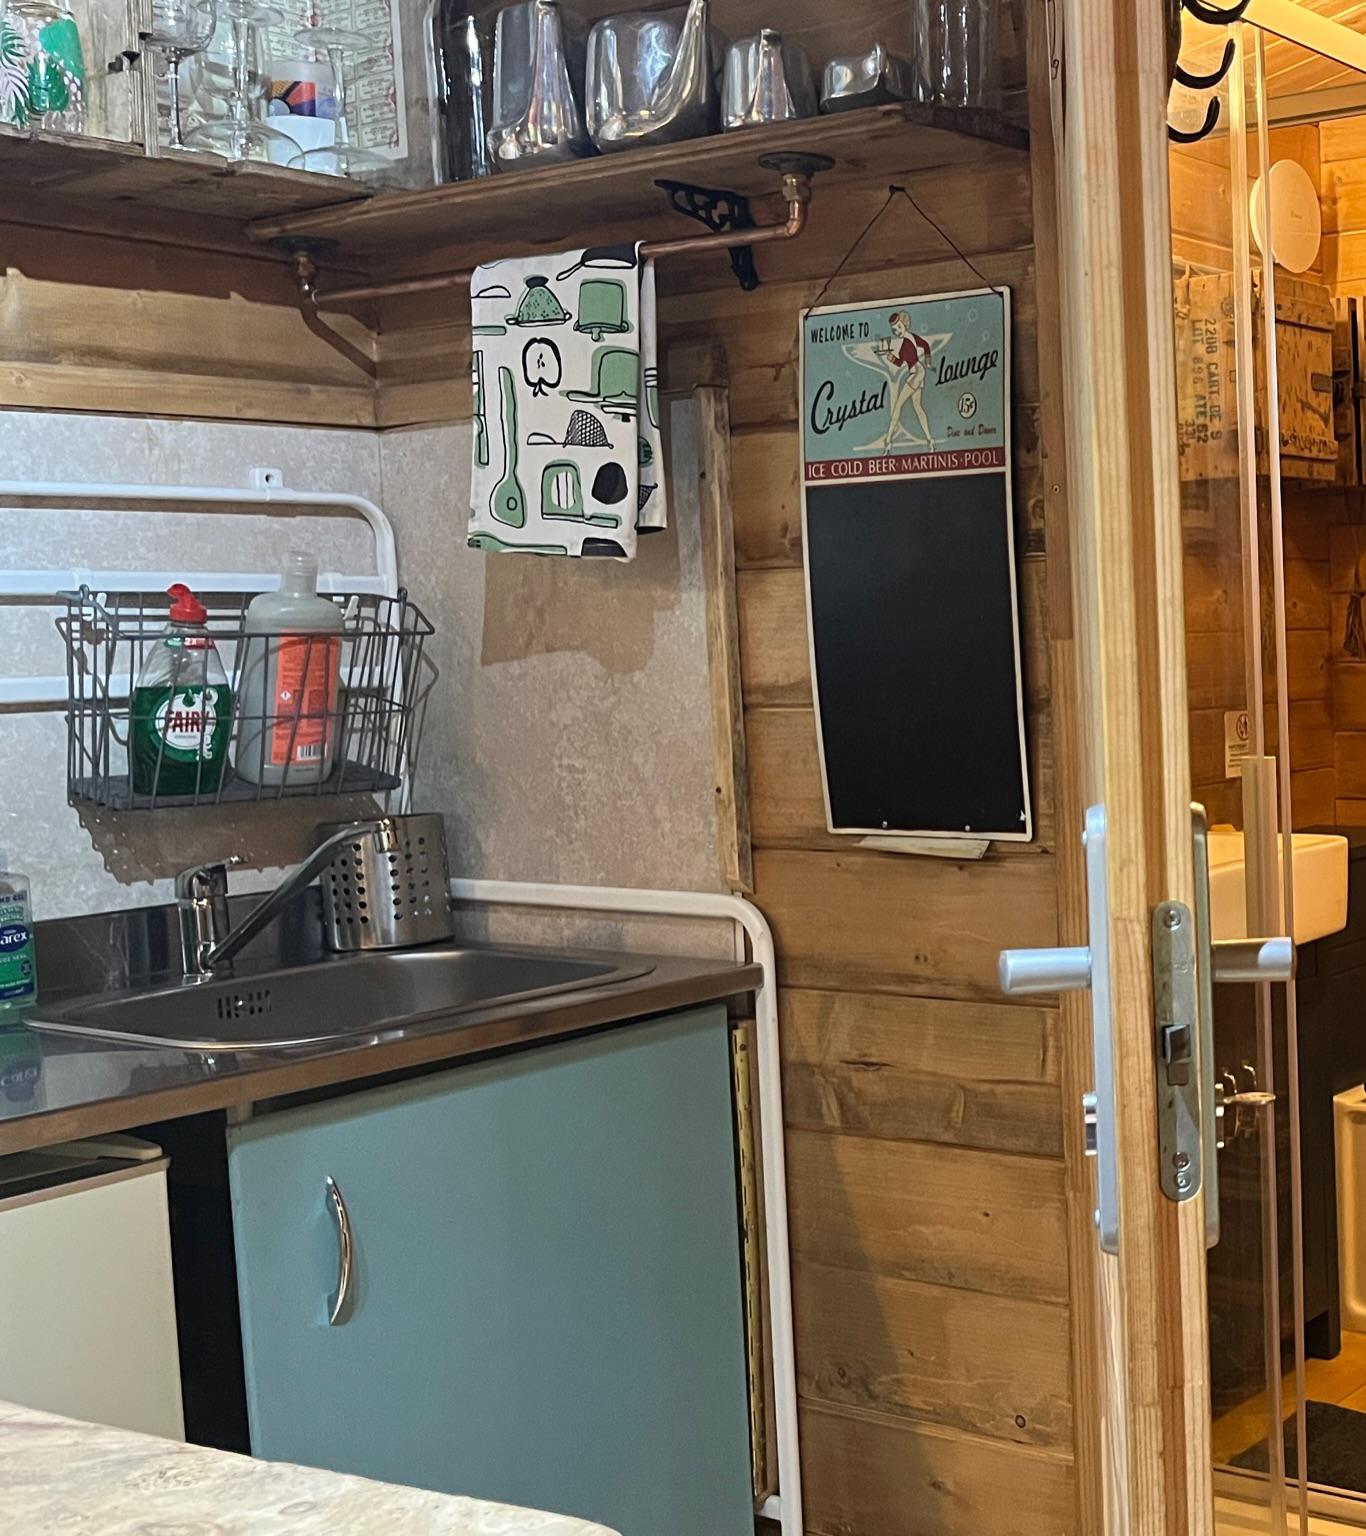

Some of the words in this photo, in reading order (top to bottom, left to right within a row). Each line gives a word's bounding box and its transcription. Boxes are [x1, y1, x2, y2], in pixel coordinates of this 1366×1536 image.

[810, 323, 855, 344] WELCOME
[858, 322, 870, 338] TO
[810, 380, 888, 435] Crystal
[808, 461, 826, 478] ICE
[831, 459, 863, 476] COLD
[869, 458, 896, 474] BEER
[901, 453, 958, 471] MARTINIS
[964, 451, 999, 466] POOL
[165, 710, 210, 733] FAIRY
